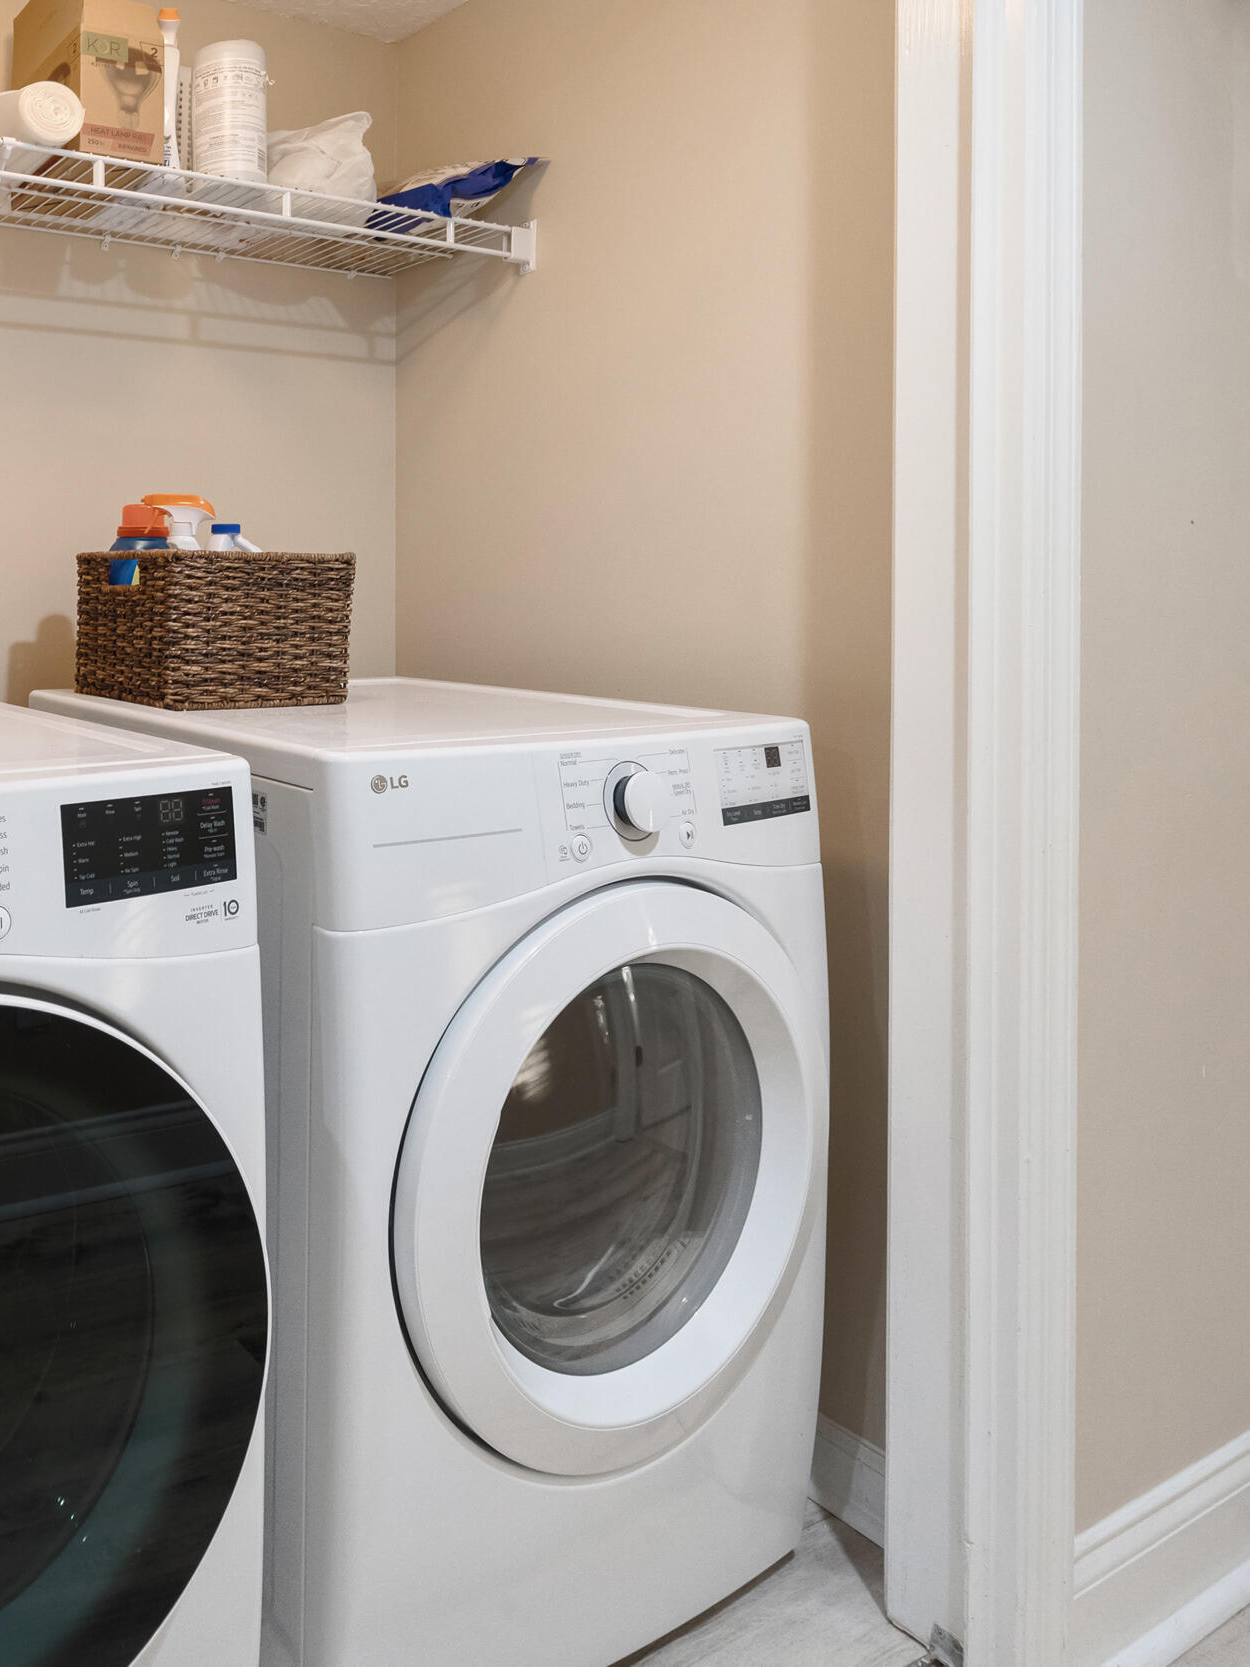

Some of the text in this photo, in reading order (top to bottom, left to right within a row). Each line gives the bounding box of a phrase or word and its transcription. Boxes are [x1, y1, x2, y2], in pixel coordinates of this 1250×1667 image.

[151, 47, 158, 59] 2
[90, 127, 109, 137] HEAT
[111, 129, 132, 139] LAMP
[390, 775, 410, 790] LG
[566, 802, 586, 810] Bedding
[200, 822, 213, 830] Delay
[170, 874, 180, 882] Soil
[127, 881, 139, 889] Spin
[223, 899, 239, 917] 10
[185, 912, 203, 921] DIRECT
[204, 909, 220, 918] DRIVE
